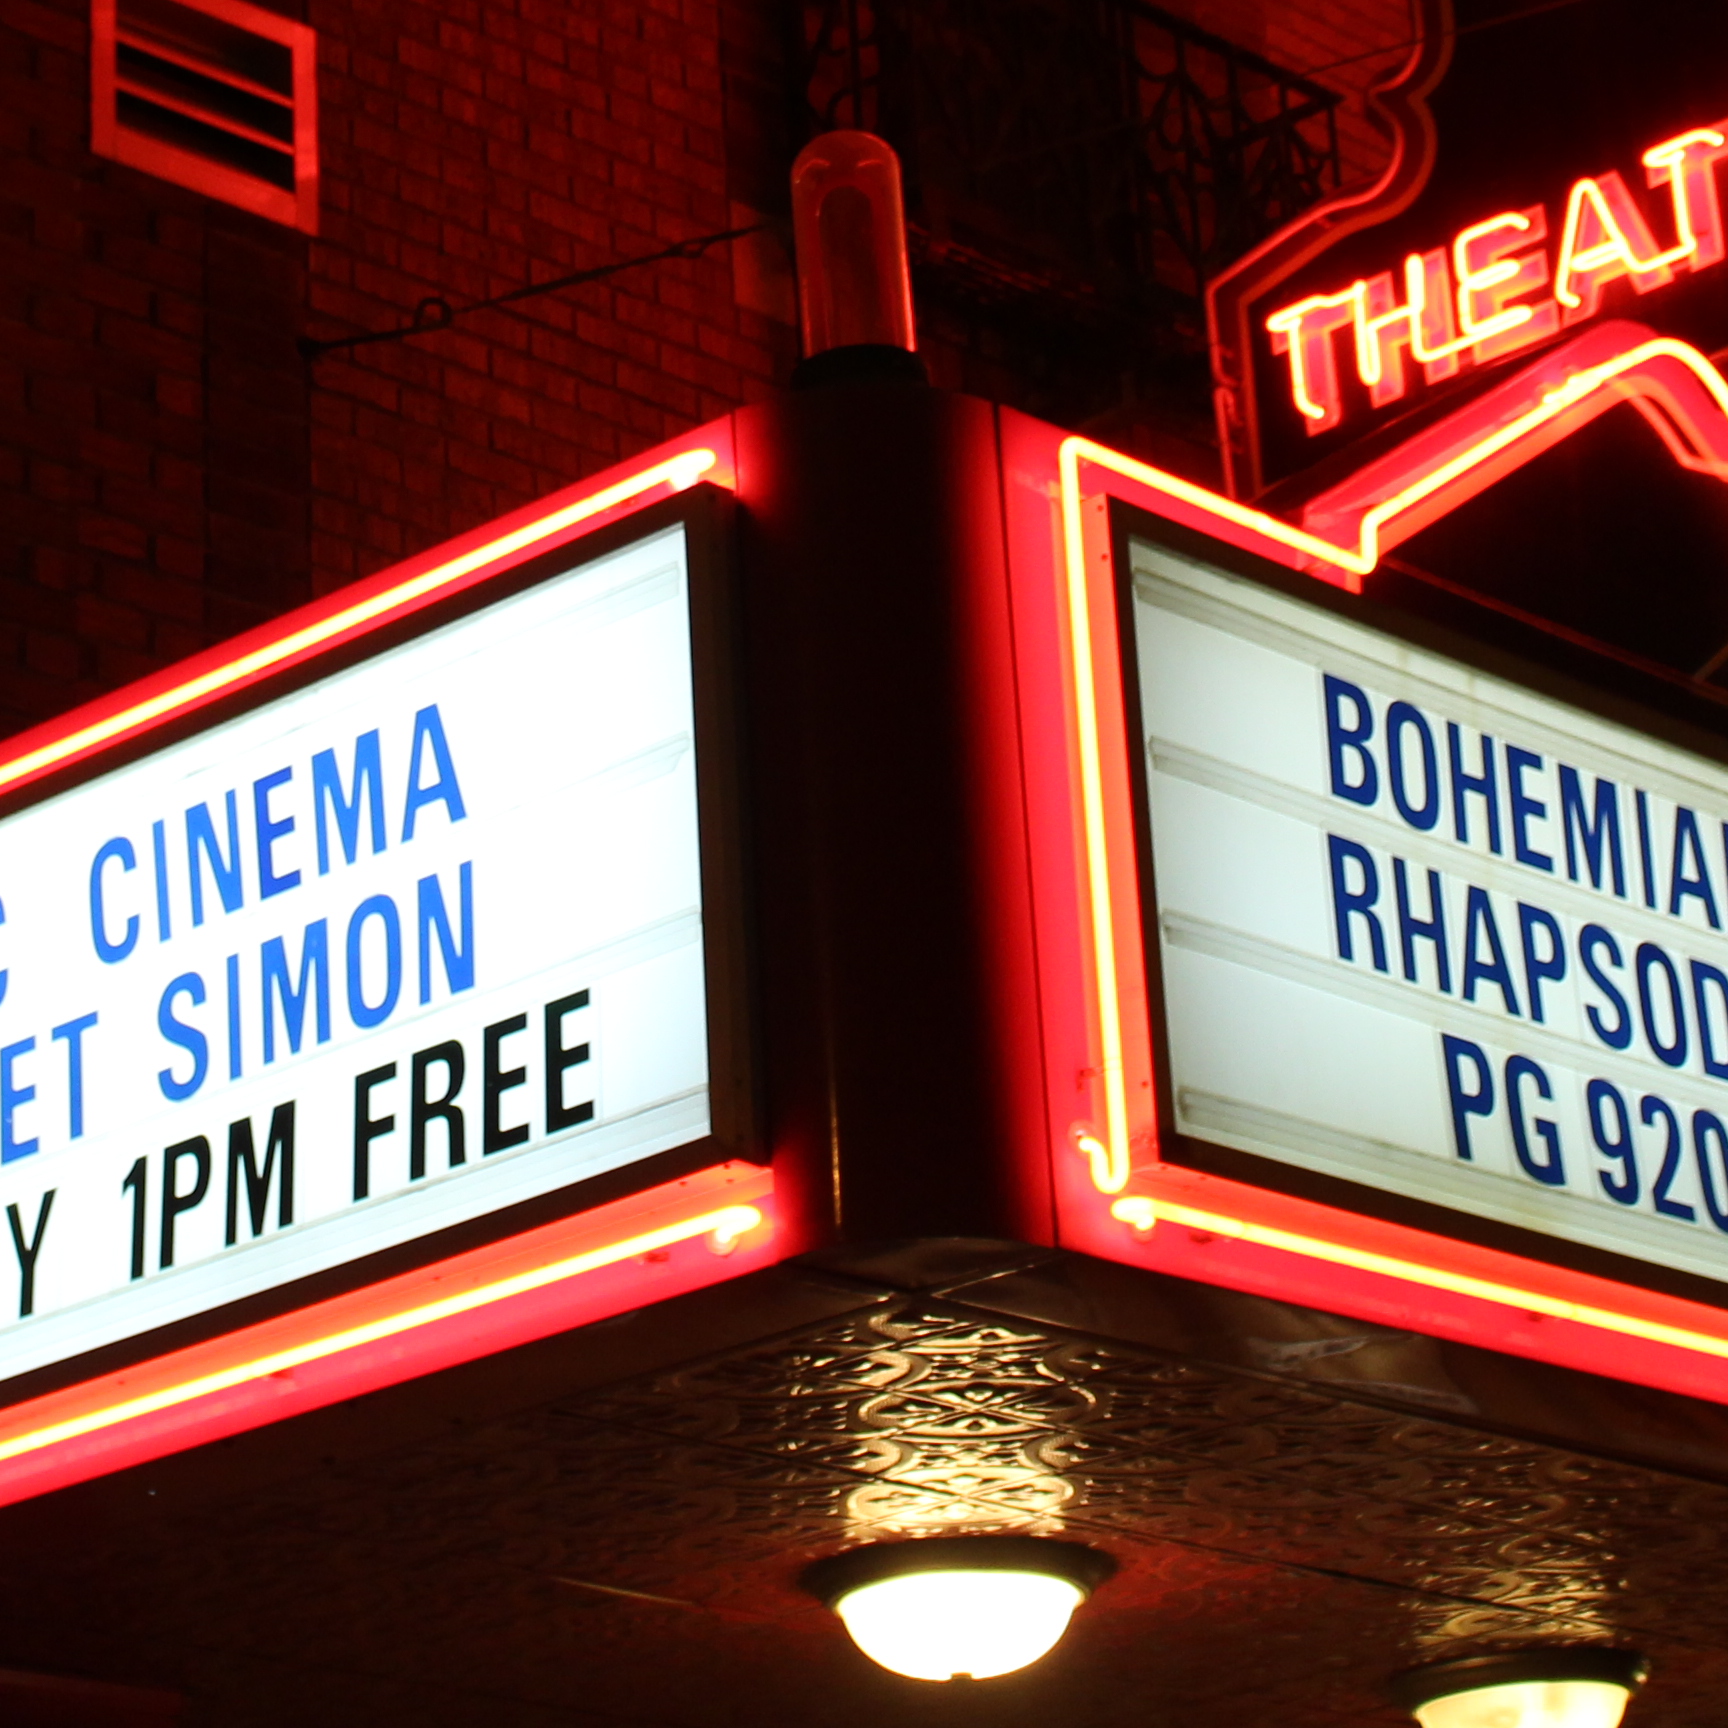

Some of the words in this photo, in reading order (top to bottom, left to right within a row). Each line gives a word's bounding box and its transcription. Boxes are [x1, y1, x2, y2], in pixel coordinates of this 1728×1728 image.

[90, 703, 468, 966] CINEMA
[0, 1012, 99, 1165] ET
[158, 860, 475, 1101] SIMON
[122, 1099, 296, 1279] 1PM
[354, 988, 596, 1201] FREE
[1442, 1034, 1565, 1186] PG
